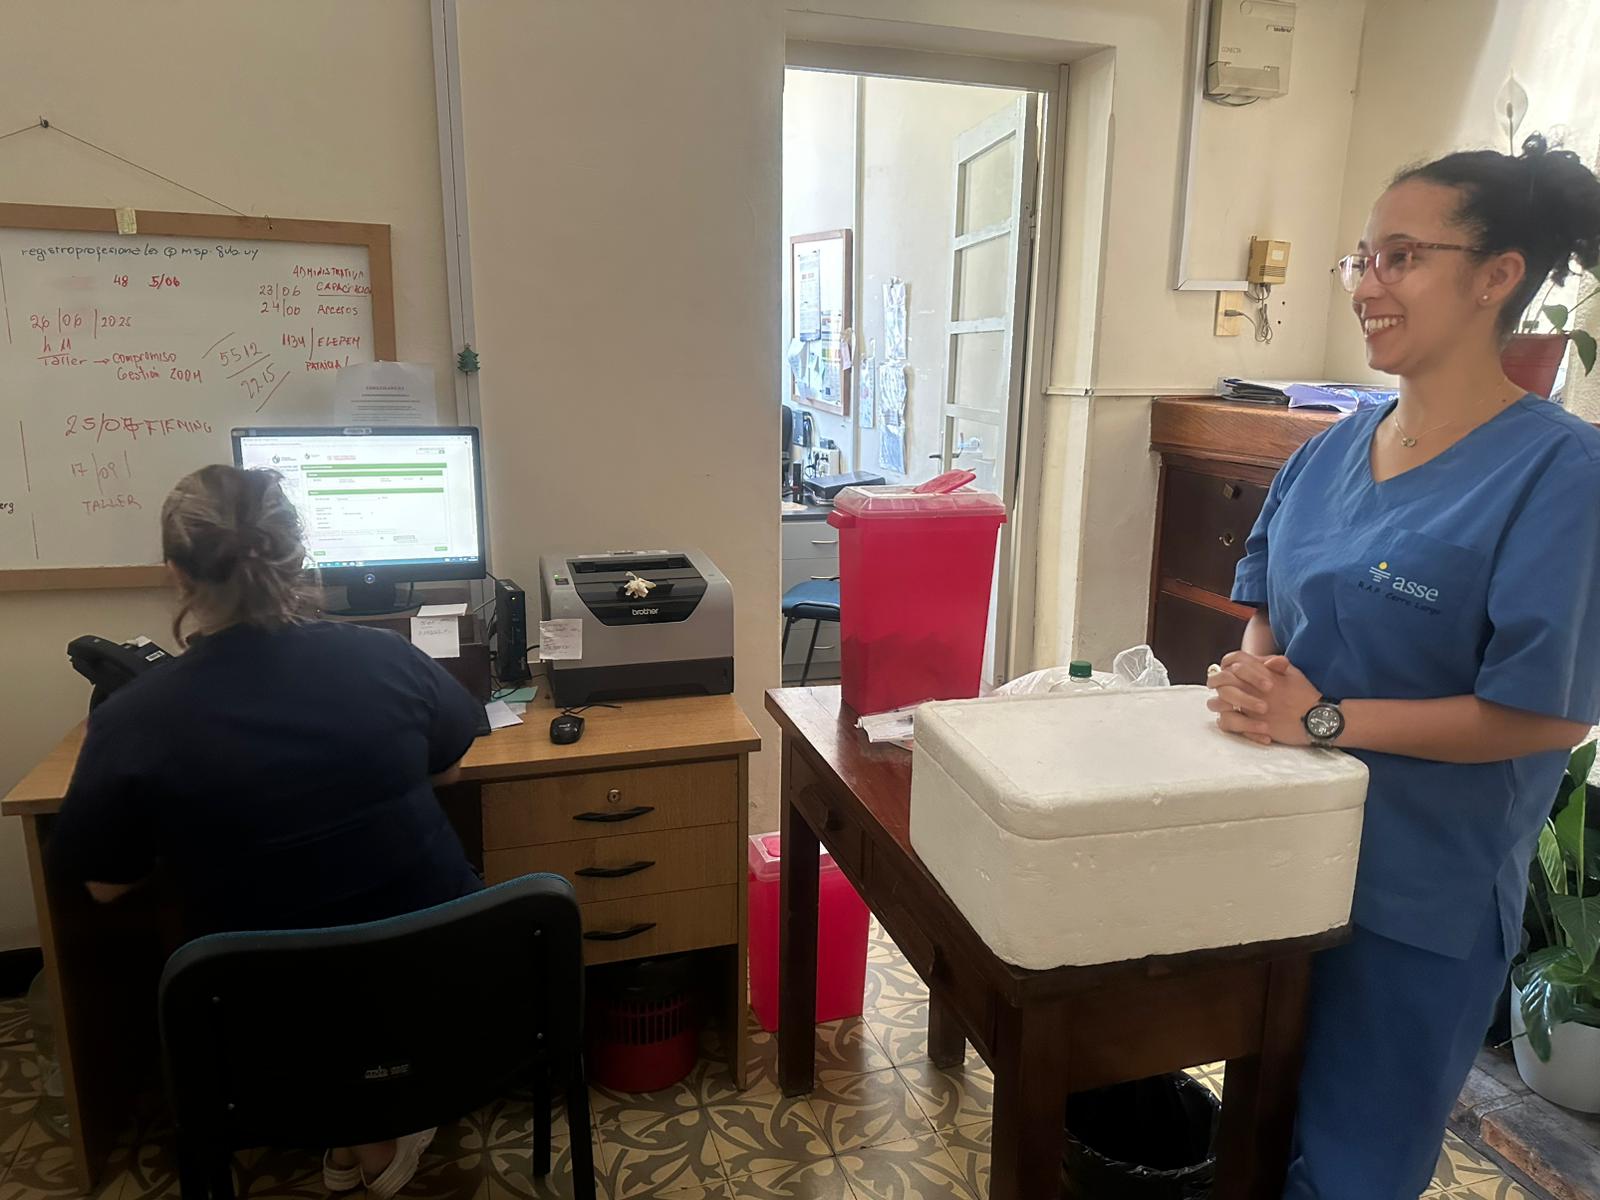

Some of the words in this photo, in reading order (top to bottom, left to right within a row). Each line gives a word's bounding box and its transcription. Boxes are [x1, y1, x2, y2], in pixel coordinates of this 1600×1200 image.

[114, 274, 129, 288] 48
[220, 342, 262, 367] 5512
[82, 494, 142, 515] TALLER
[1392, 576, 1439, 602] asse
[631, 608, 659, 616] brother
